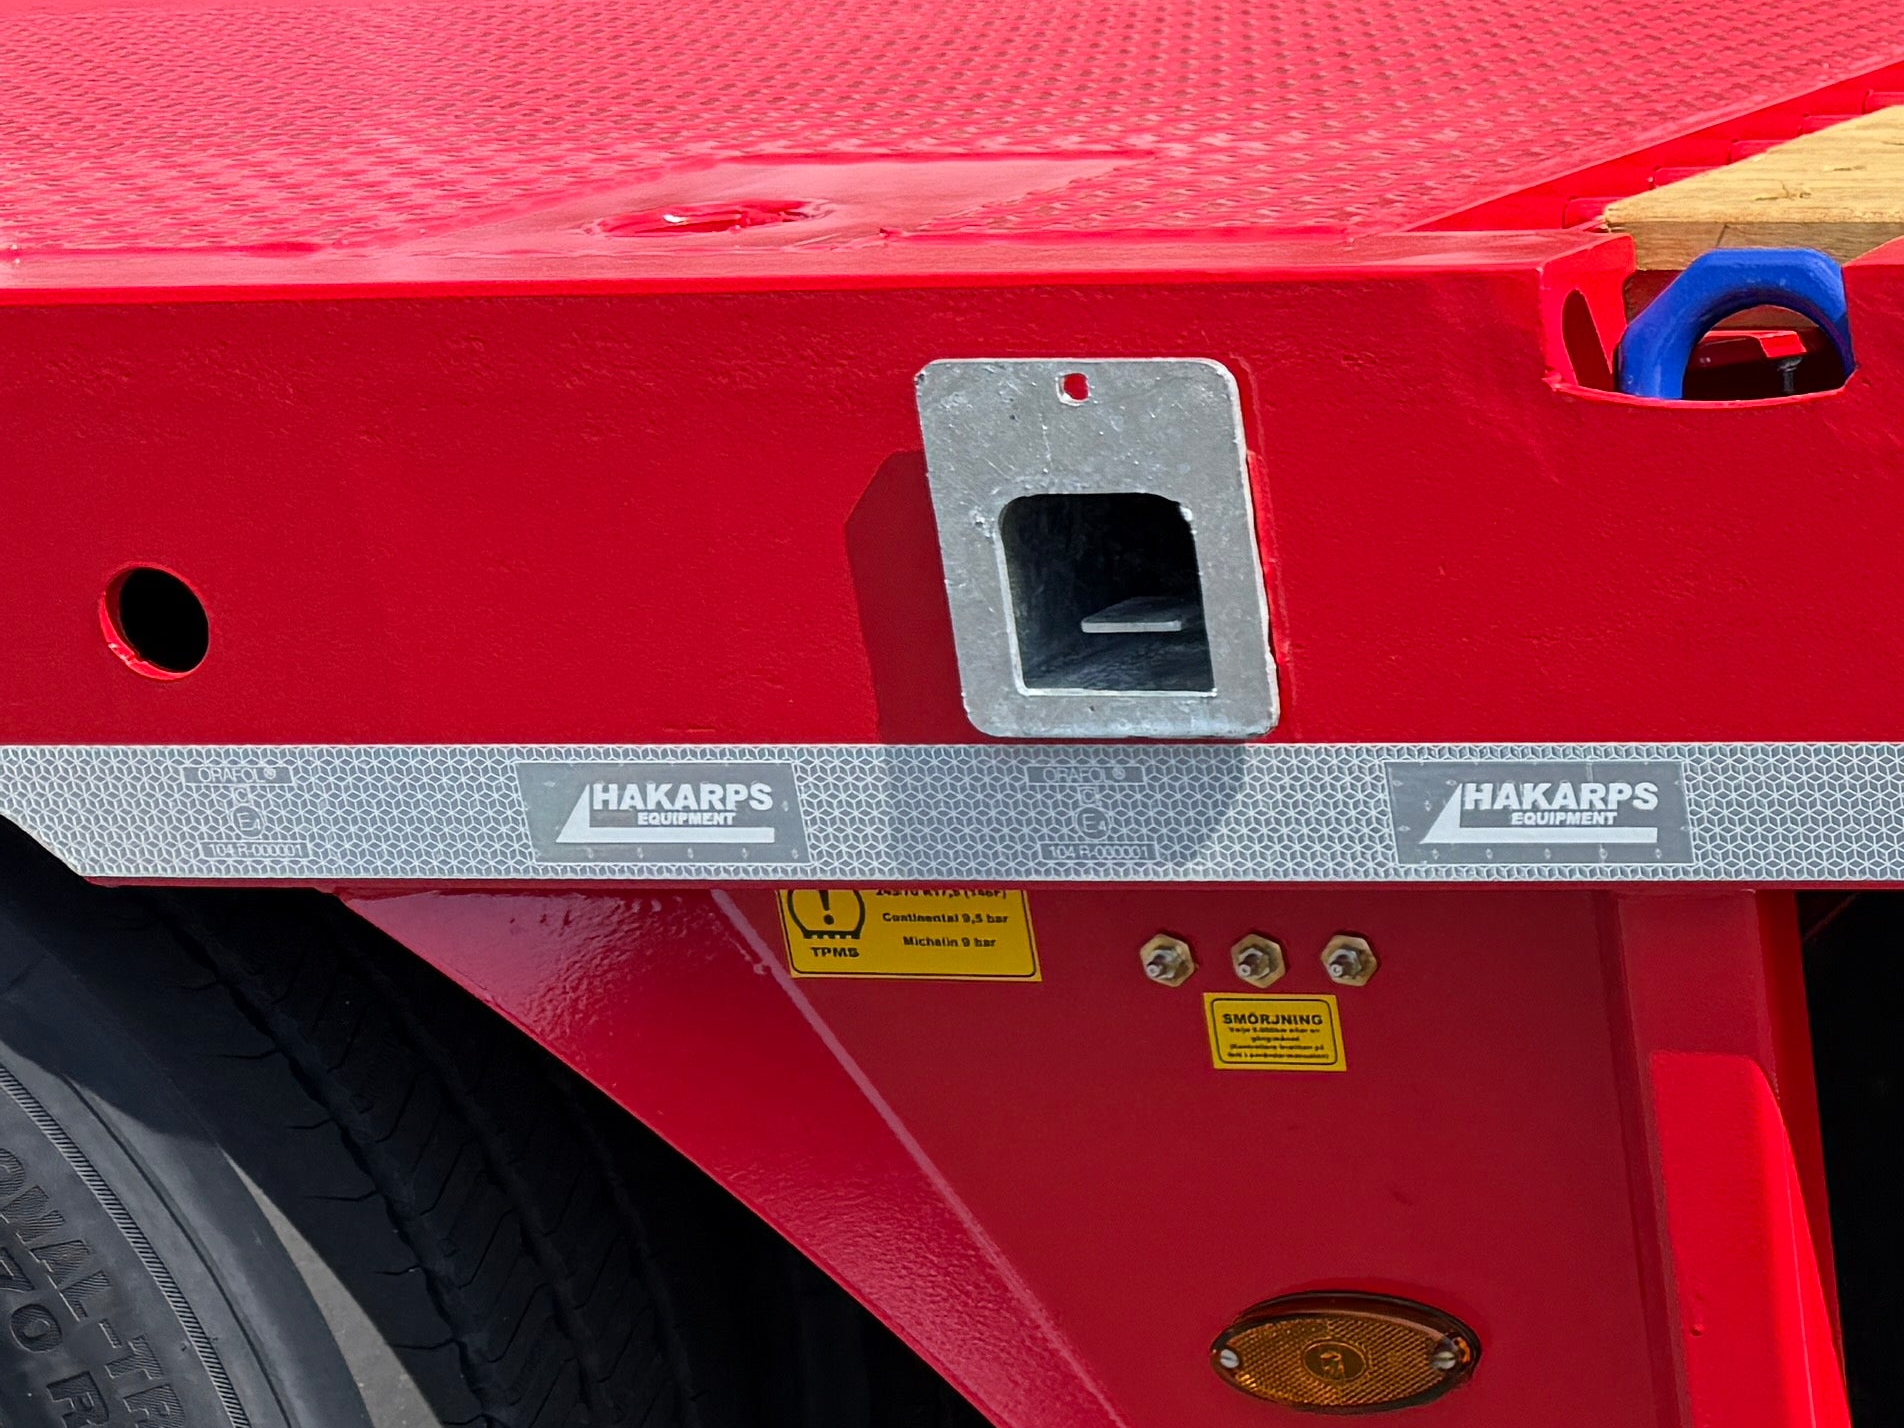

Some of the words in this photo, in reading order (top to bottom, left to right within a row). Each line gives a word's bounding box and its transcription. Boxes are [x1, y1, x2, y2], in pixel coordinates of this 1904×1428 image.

[591, 782, 774, 811] HAKARPS
[1462, 781, 1659, 811] HAKARPS
[636, 810, 737, 826] EQUIPMENT
[1510, 810, 1618, 826] EQUIPMENT
[882, 912, 959, 923] Continental
[986, 914, 1009, 924] bar
[961, 937, 971, 948] 9
[974, 938, 997, 948] bar
[812, 946, 860, 959] TPMS
